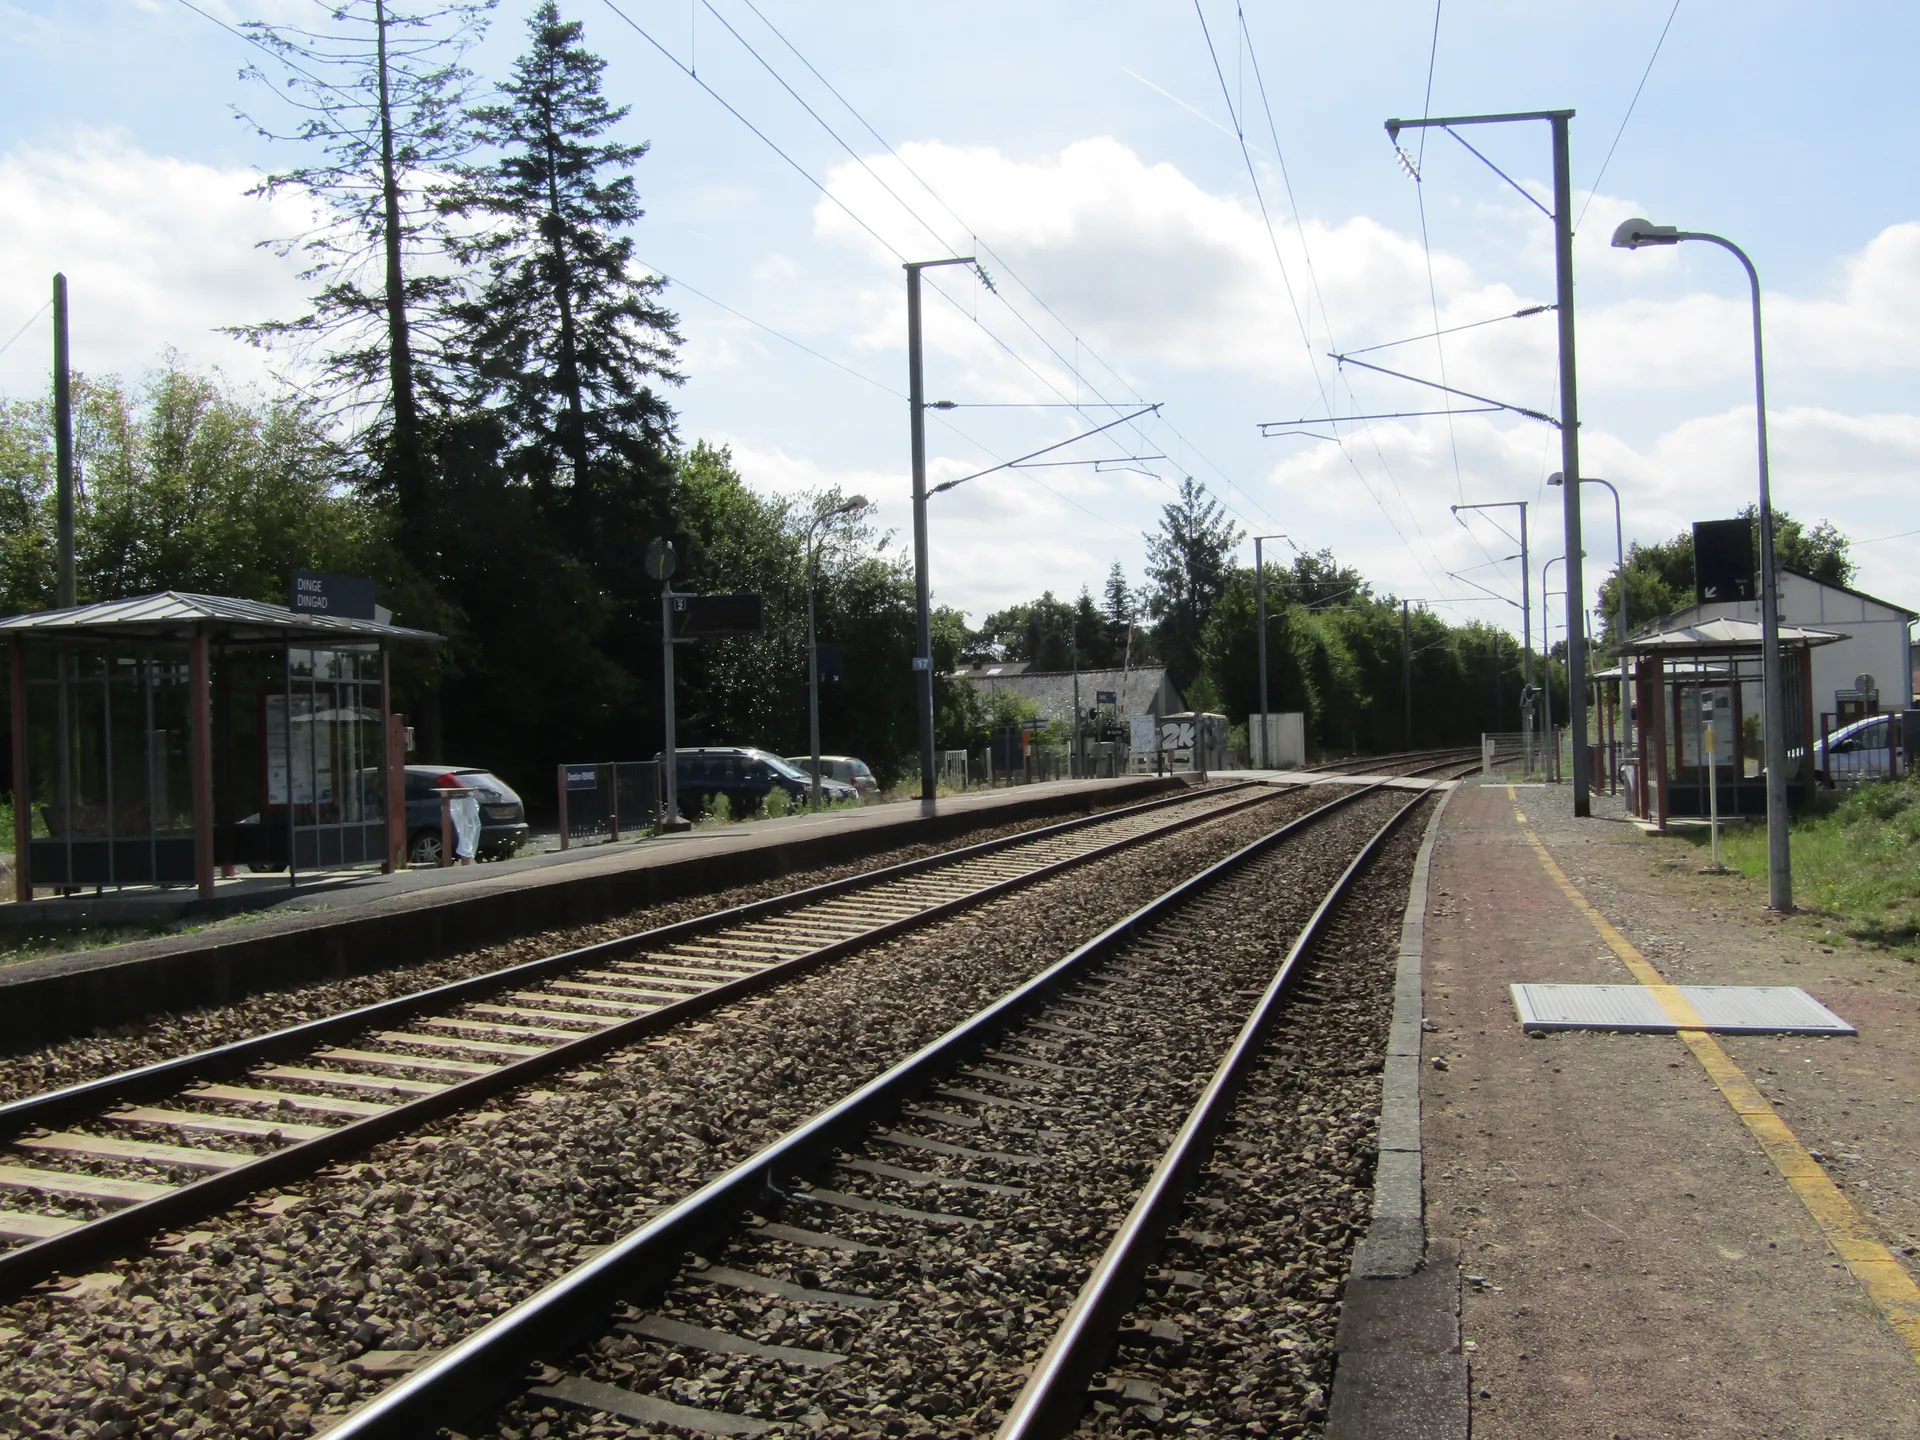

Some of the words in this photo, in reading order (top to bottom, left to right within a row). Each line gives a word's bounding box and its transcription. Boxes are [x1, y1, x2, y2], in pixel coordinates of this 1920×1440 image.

[297, 578, 322, 592] DINGE
[1739, 585, 1744, 596] 1
[297, 594, 328, 609] DINGAD
[918, 659, 929, 668] 17
[1160, 722, 1196, 750] 2K
